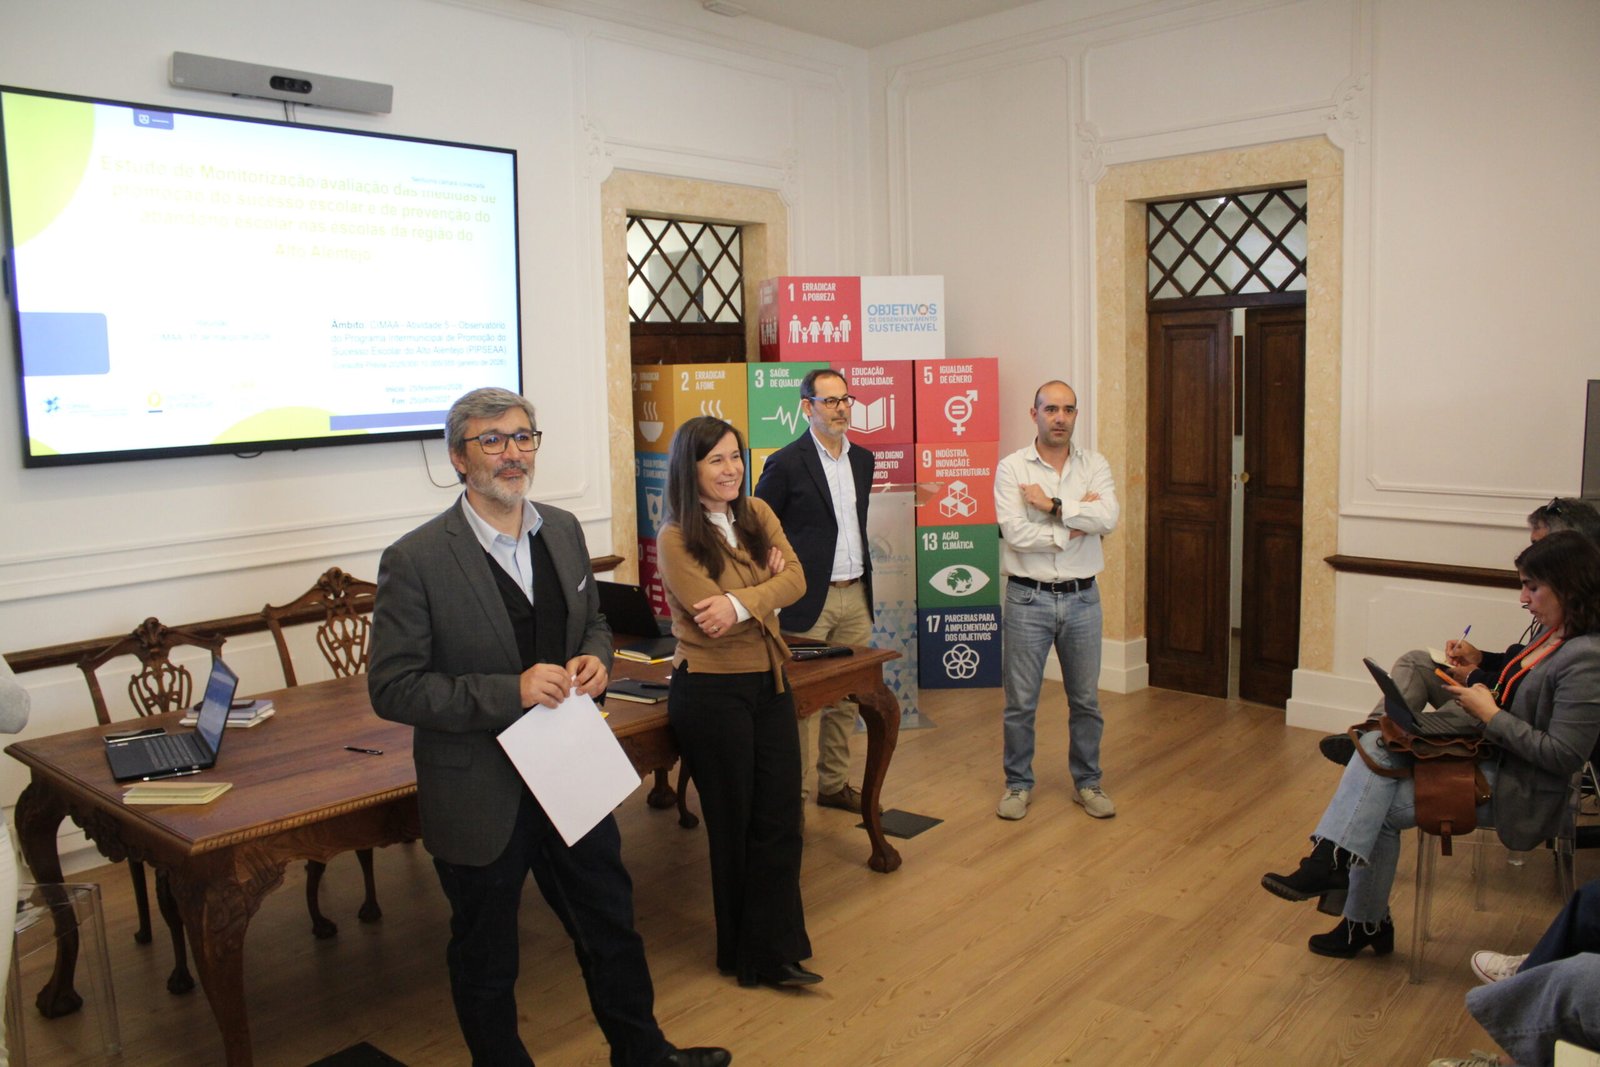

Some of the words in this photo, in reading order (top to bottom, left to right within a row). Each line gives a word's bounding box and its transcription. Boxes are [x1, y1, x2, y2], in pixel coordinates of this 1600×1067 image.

[200, 164, 315, 190] Monitorização
[237, 193, 304, 209] sucesso
[309, 199, 363, 213] escolar
[367, 203, 376, 215] e
[380, 202, 398, 216] de
[402, 206, 471, 222] prevenção
[474, 210, 491, 223] do
[330, 222, 386, 237] escolas
[391, 224, 409, 238] da
[412, 227, 454, 244] região
[457, 229, 474, 242] do
[310, 245, 373, 262] Alentejo
[802, 282, 836, 292] ERRADICAR
[788, 283, 795, 302] 1
[802, 293, 807, 301] A
[807, 293, 836, 301] POBREZA
[867, 303, 937, 316] OBJETIVOS
[406, 320, 442, 329] Atividade
[458, 320, 506, 329] Observatório
[344, 333, 386, 345] Programa
[388, 333, 444, 344] Intermunicipal
[457, 332, 495, 344] Promoção
[497, 333, 506, 342] do
[371, 346, 401, 355] Escolar
[416, 345, 431, 354] Alto
[433, 345, 465, 356] Alentejo
[466, 344, 507, 355] (PIPSEAA)
[695, 370, 726, 380] ERRADICAR
[769, 367, 790, 377] SAÚDE
[851, 366, 885, 377] EDUCAÇÃO
[939, 365, 974, 375] IGUALDADE
[755, 369, 764, 388] 3
[923, 366, 933, 385] 5
[939, 375, 948, 384] DE
[681, 371, 690, 391] 2
[695, 381, 700, 390] A
[700, 381, 715, 390] FOME
[769, 379, 778, 388] DE
[852, 377, 860, 386] DE
[861, 376, 894, 386] QUALIDADE
[885, 450, 904, 459] DIGNO
[922, 450, 932, 468] 9
[935, 458, 965, 468] INOVAÇÃO
[966, 458, 970, 467] E
[873, 470, 889, 480] MICO
[935, 467, 990, 478] INFRAESTRUTURAS
[942, 531, 959, 541] AÇÃO
[922, 533, 938, 551] 13
[942, 540, 974, 550] CLIMÁTICA
[944, 613, 978, 623] PARCERIAS
[979, 613, 995, 622] PARA
[926, 614, 941, 633] 17
[945, 624, 950, 632] A
[950, 622, 998, 632] IMPLEMENTAÇÃO
[945, 633, 958, 641] DOS
[958, 632, 992, 642] OBJETIVOS
